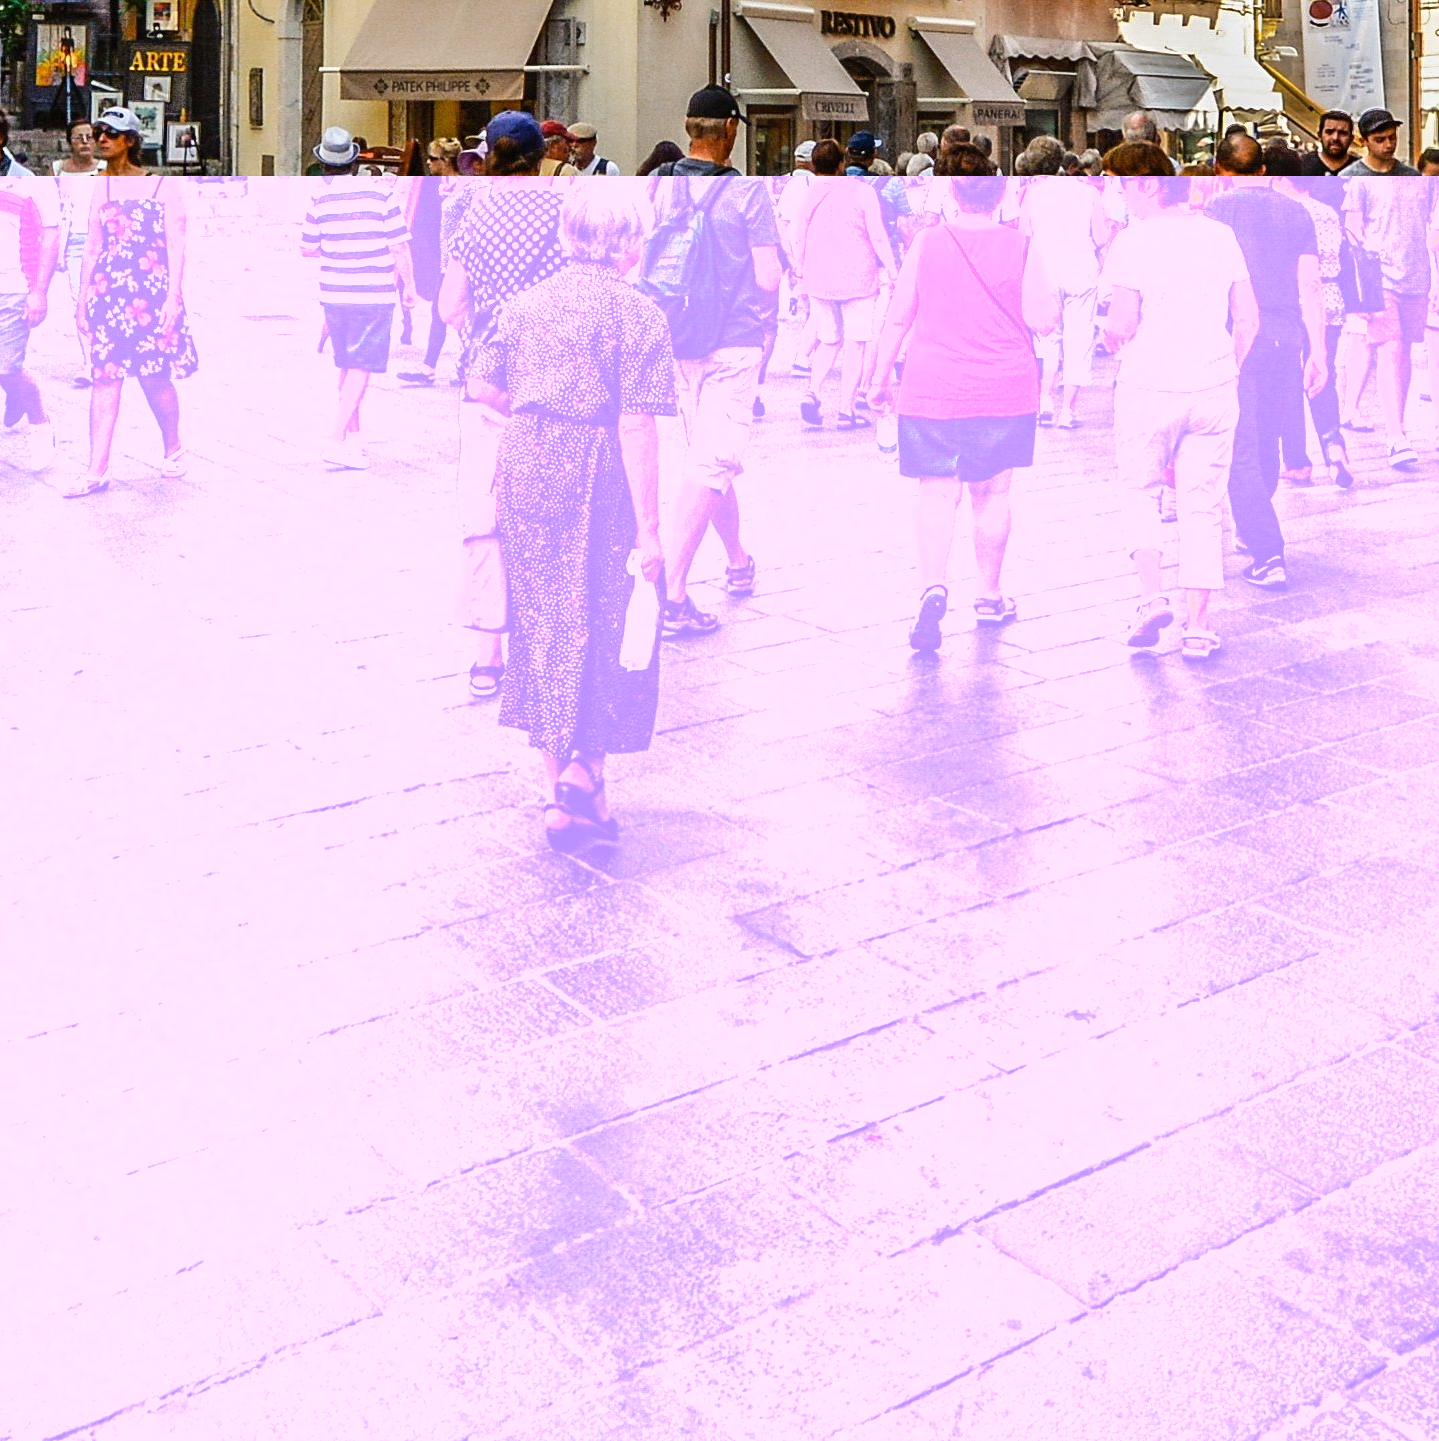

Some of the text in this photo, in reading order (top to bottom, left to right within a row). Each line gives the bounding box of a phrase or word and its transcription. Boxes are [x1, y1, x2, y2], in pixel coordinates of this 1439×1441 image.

[820, 9, 896, 39] RESTIVO
[129, 50, 187, 72] ARTE
[391, 80, 470, 93] PATEK PHILIPPE
[815, 101, 855, 114] CRIVELLI
[977, 108, 1021, 120] PANERAI
